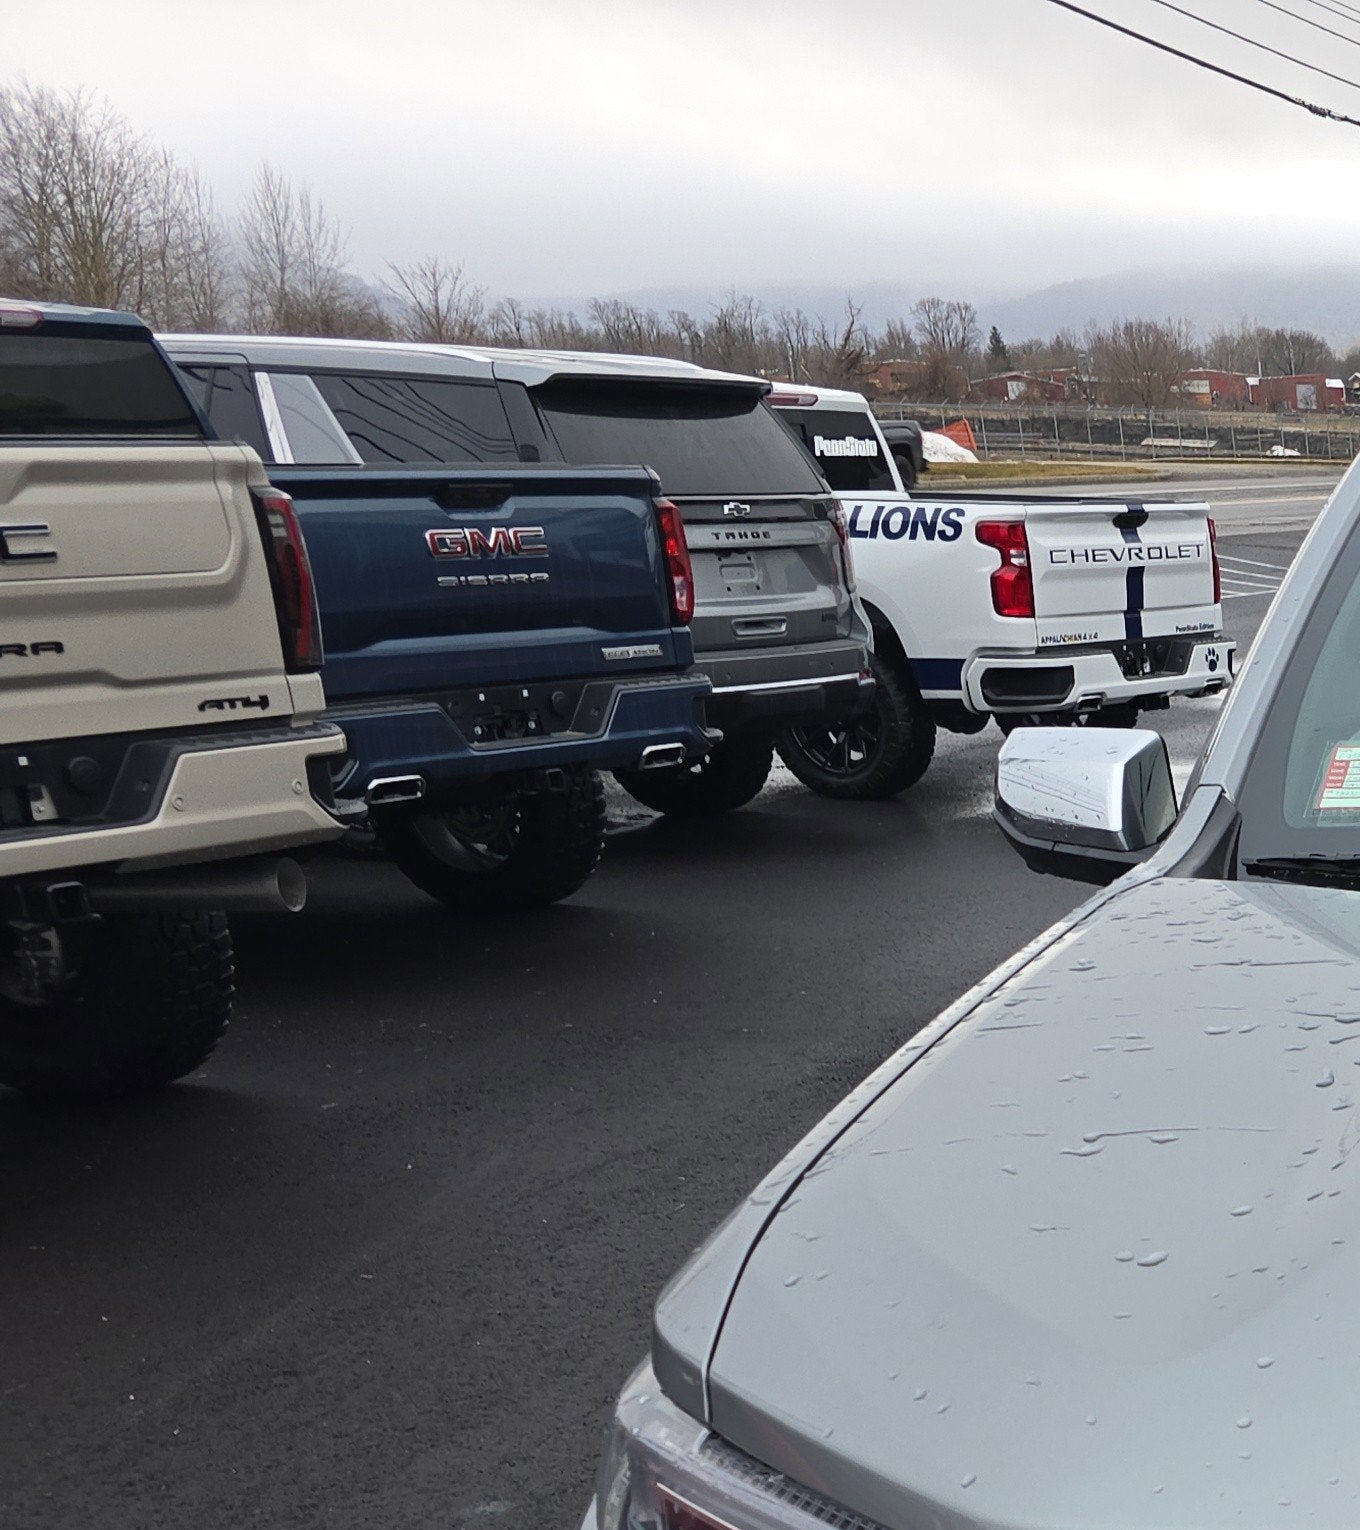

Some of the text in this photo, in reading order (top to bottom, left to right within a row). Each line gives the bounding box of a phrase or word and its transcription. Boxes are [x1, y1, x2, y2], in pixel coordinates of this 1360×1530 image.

[849, 504, 966, 543] LIONS
[424, 526, 549, 561] GMC
[1049, 543, 1204, 565] CHEVROLET
[437, 572, 550, 587] SIERRA
[197, 694, 270, 713] AT4
